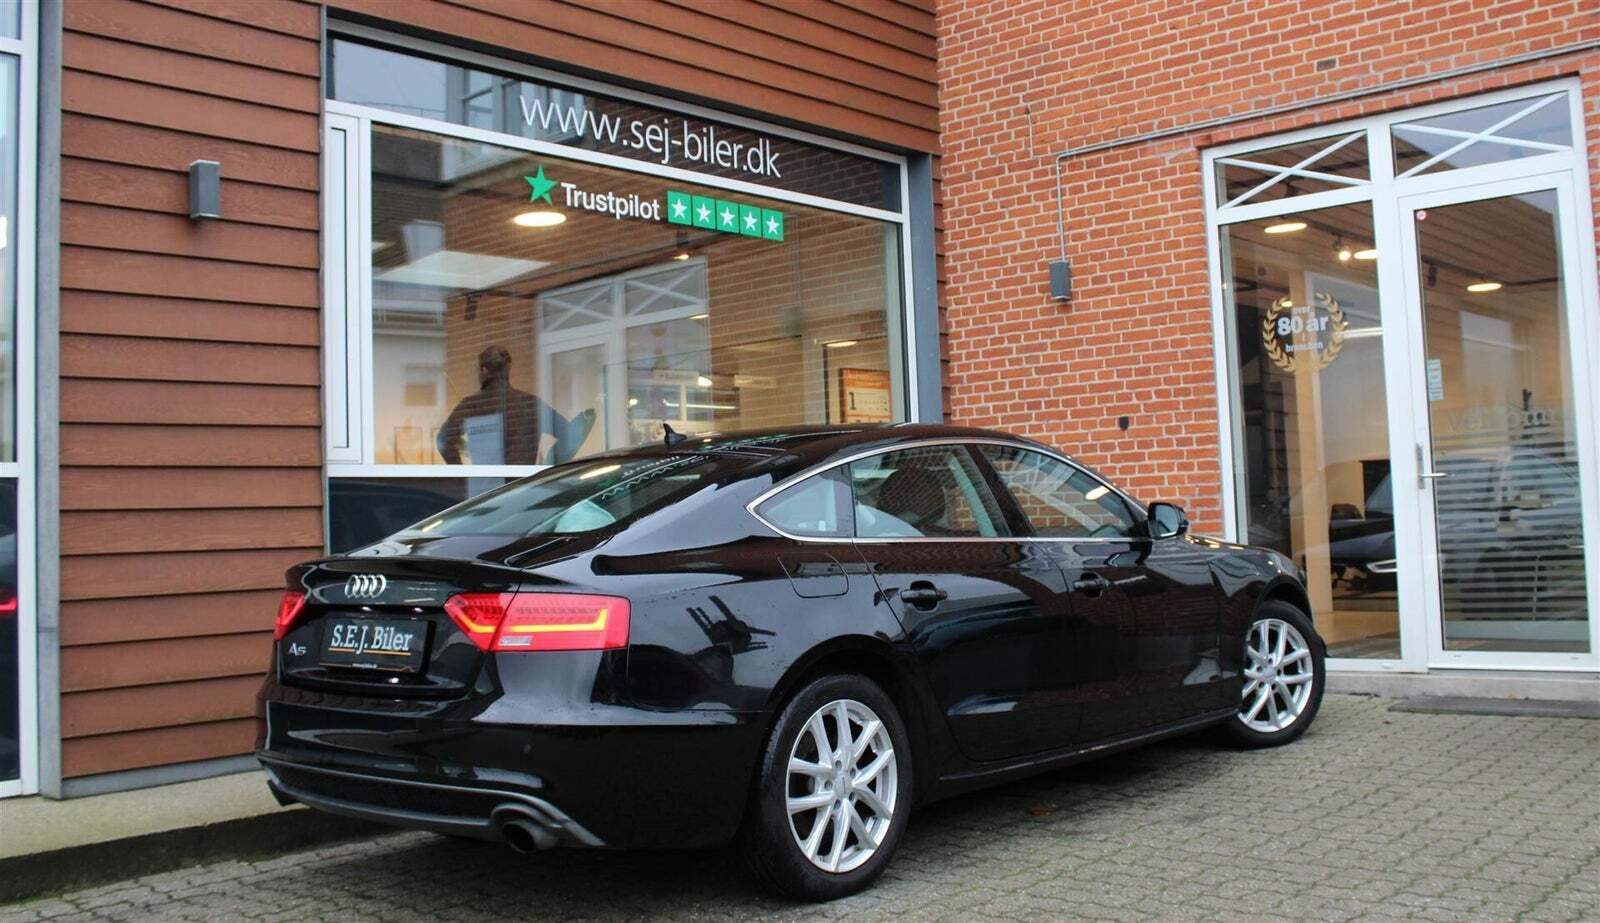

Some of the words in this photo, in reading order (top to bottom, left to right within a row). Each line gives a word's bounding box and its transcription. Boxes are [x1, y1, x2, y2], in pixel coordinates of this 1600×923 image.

[520, 95, 782, 178] www.sej-biler.dk
[560, 182, 661, 221] Trustpilot
[1277, 316, 1304, 336] 80
[288, 642, 307, 656] A5
[331, 624, 368, 655] S.E.J.
[371, 626, 414, 651] Biler
